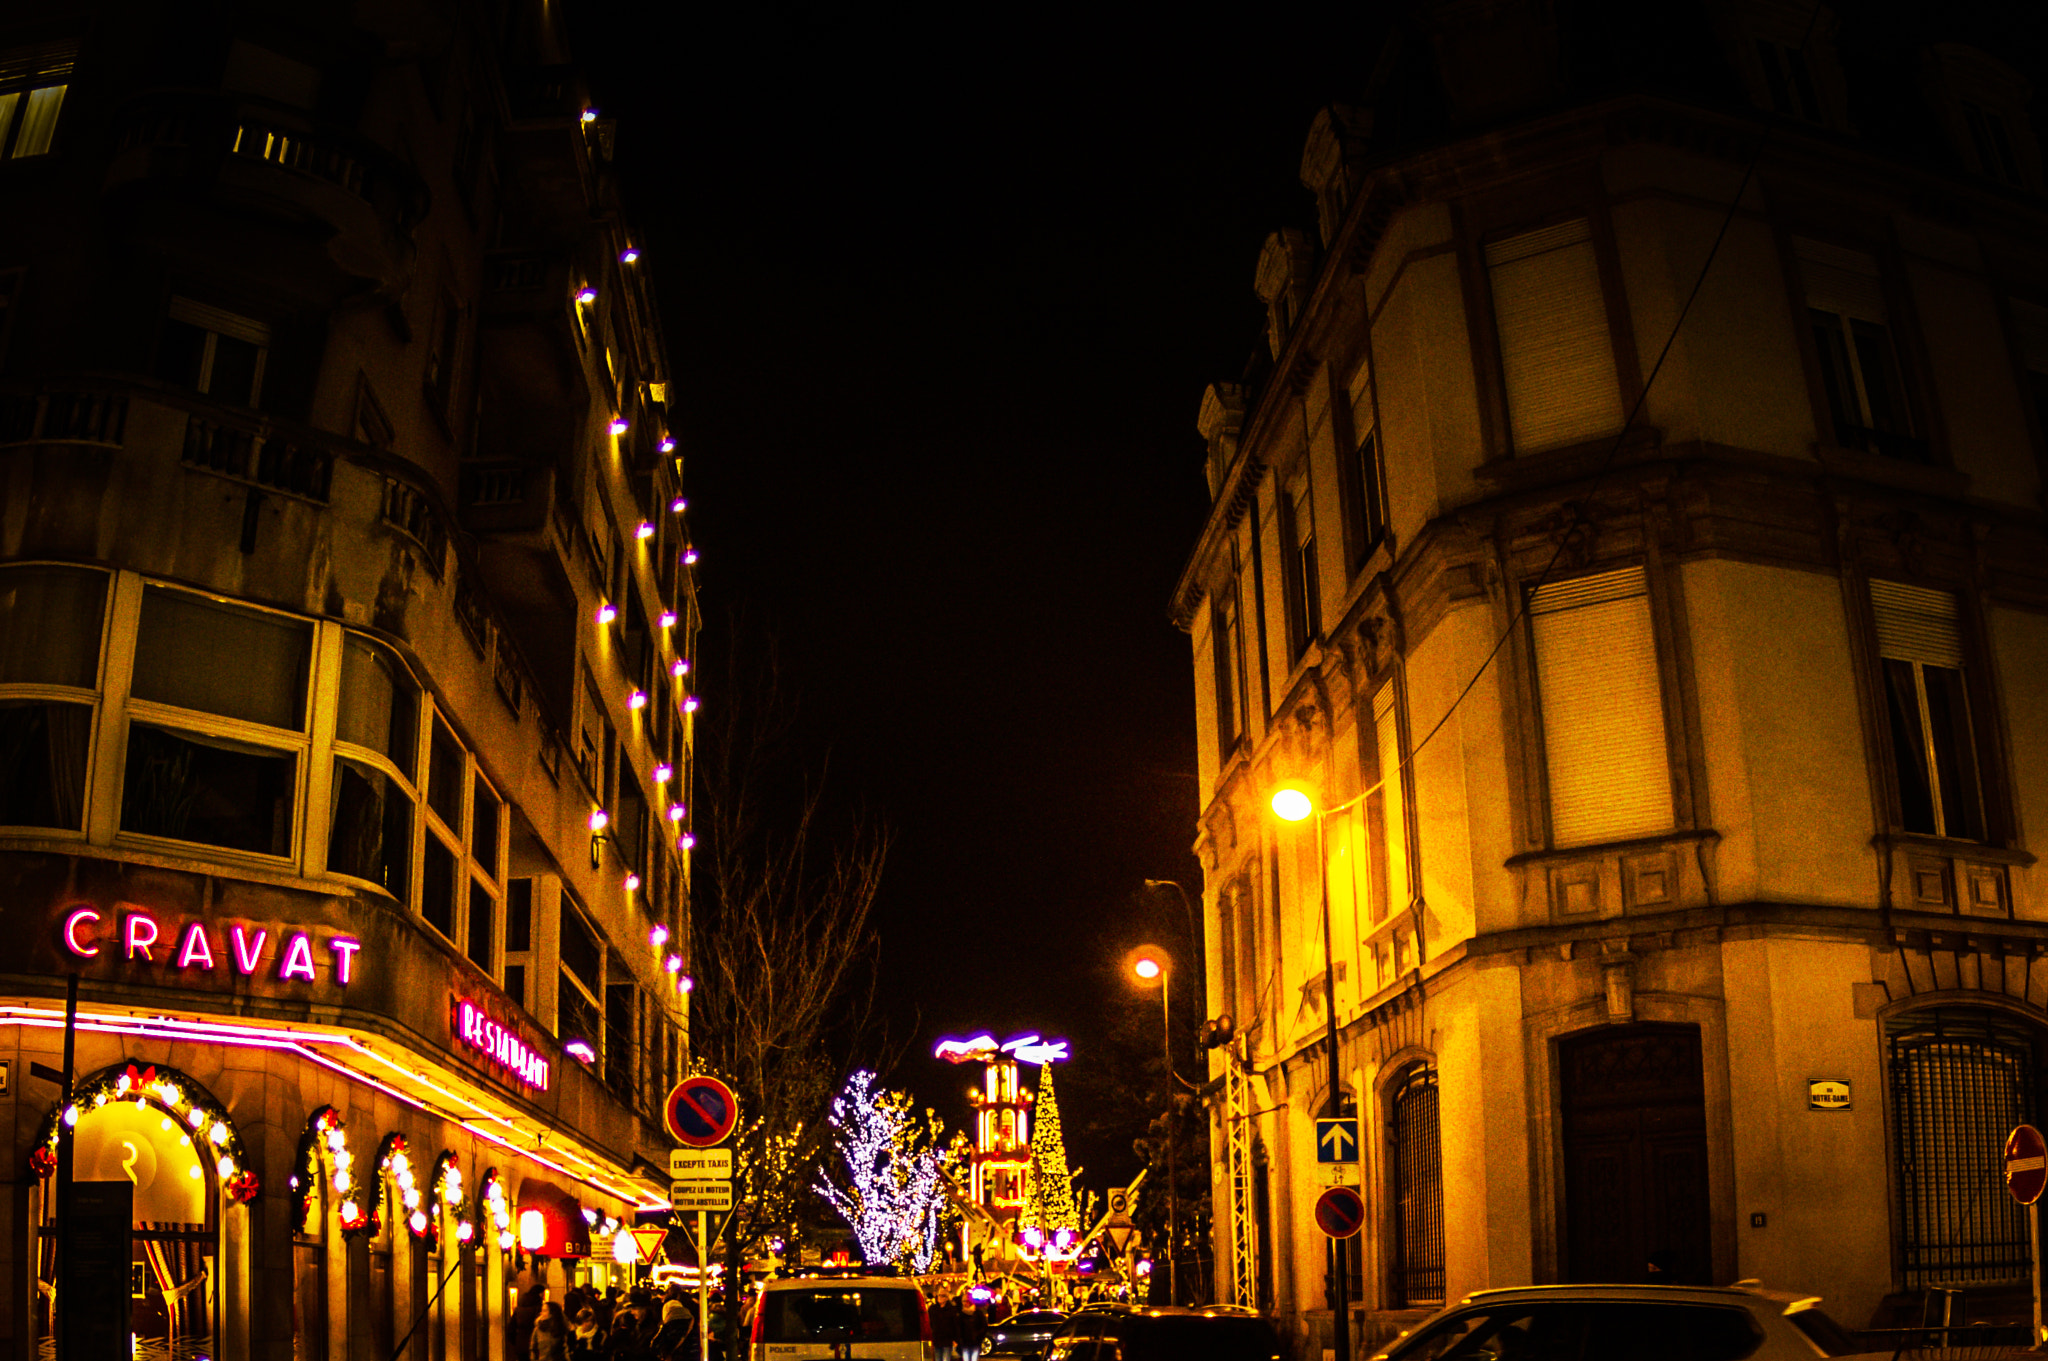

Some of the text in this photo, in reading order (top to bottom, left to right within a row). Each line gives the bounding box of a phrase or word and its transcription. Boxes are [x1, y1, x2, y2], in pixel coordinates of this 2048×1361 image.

[64, 908, 360, 984] CRAVAT
[460, 1003, 549, 1091] RESTAURANT
[1812, 1094, 1849, 1102] NOTRE-DAME
[708, 1160, 729, 1168] TAXIS
[673, 1186, 730, 1194] COUPEZ LE MOTEUR
[674, 1198, 729, 1206] MOTOR ABSTELLEN
[769, 1346, 796, 1354] POLICE
